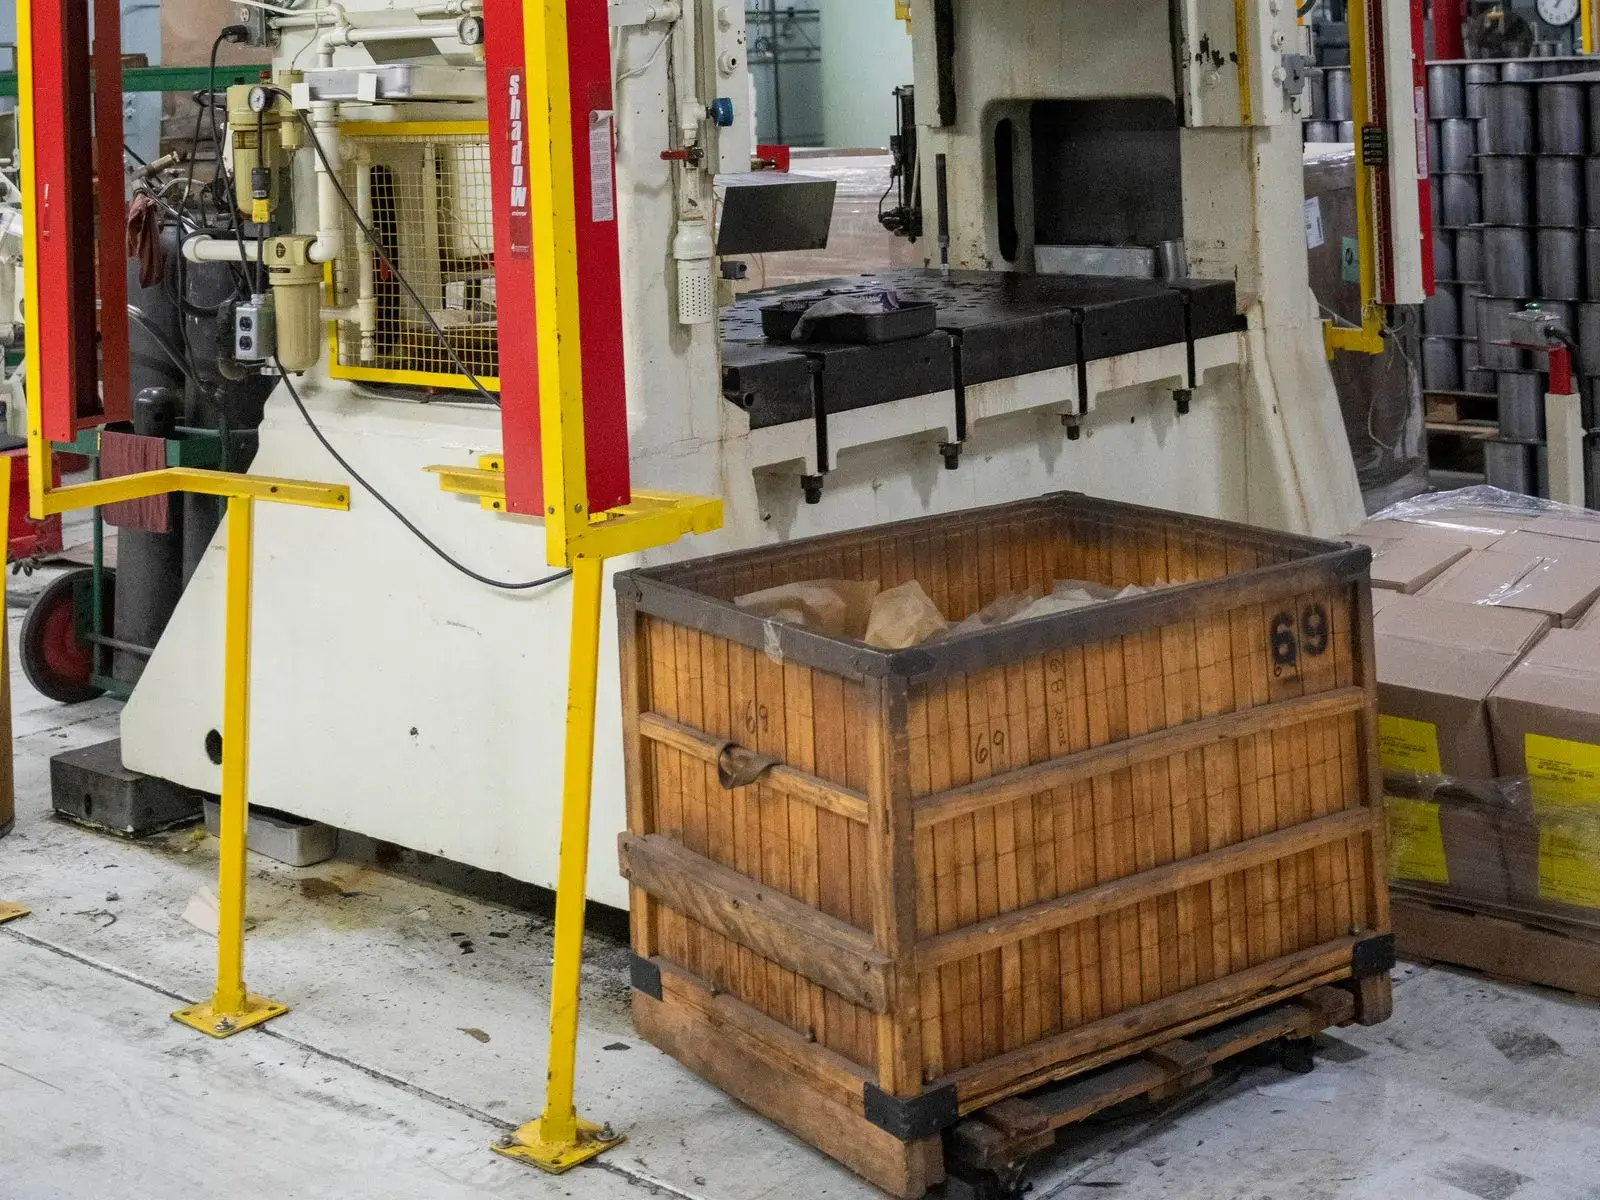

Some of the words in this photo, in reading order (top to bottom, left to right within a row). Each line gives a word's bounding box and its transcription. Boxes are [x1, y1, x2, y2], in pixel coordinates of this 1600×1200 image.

[1270, 603, 1329, 666] 69
[745, 699, 769, 734] 69
[975, 731, 1005, 764] 69
